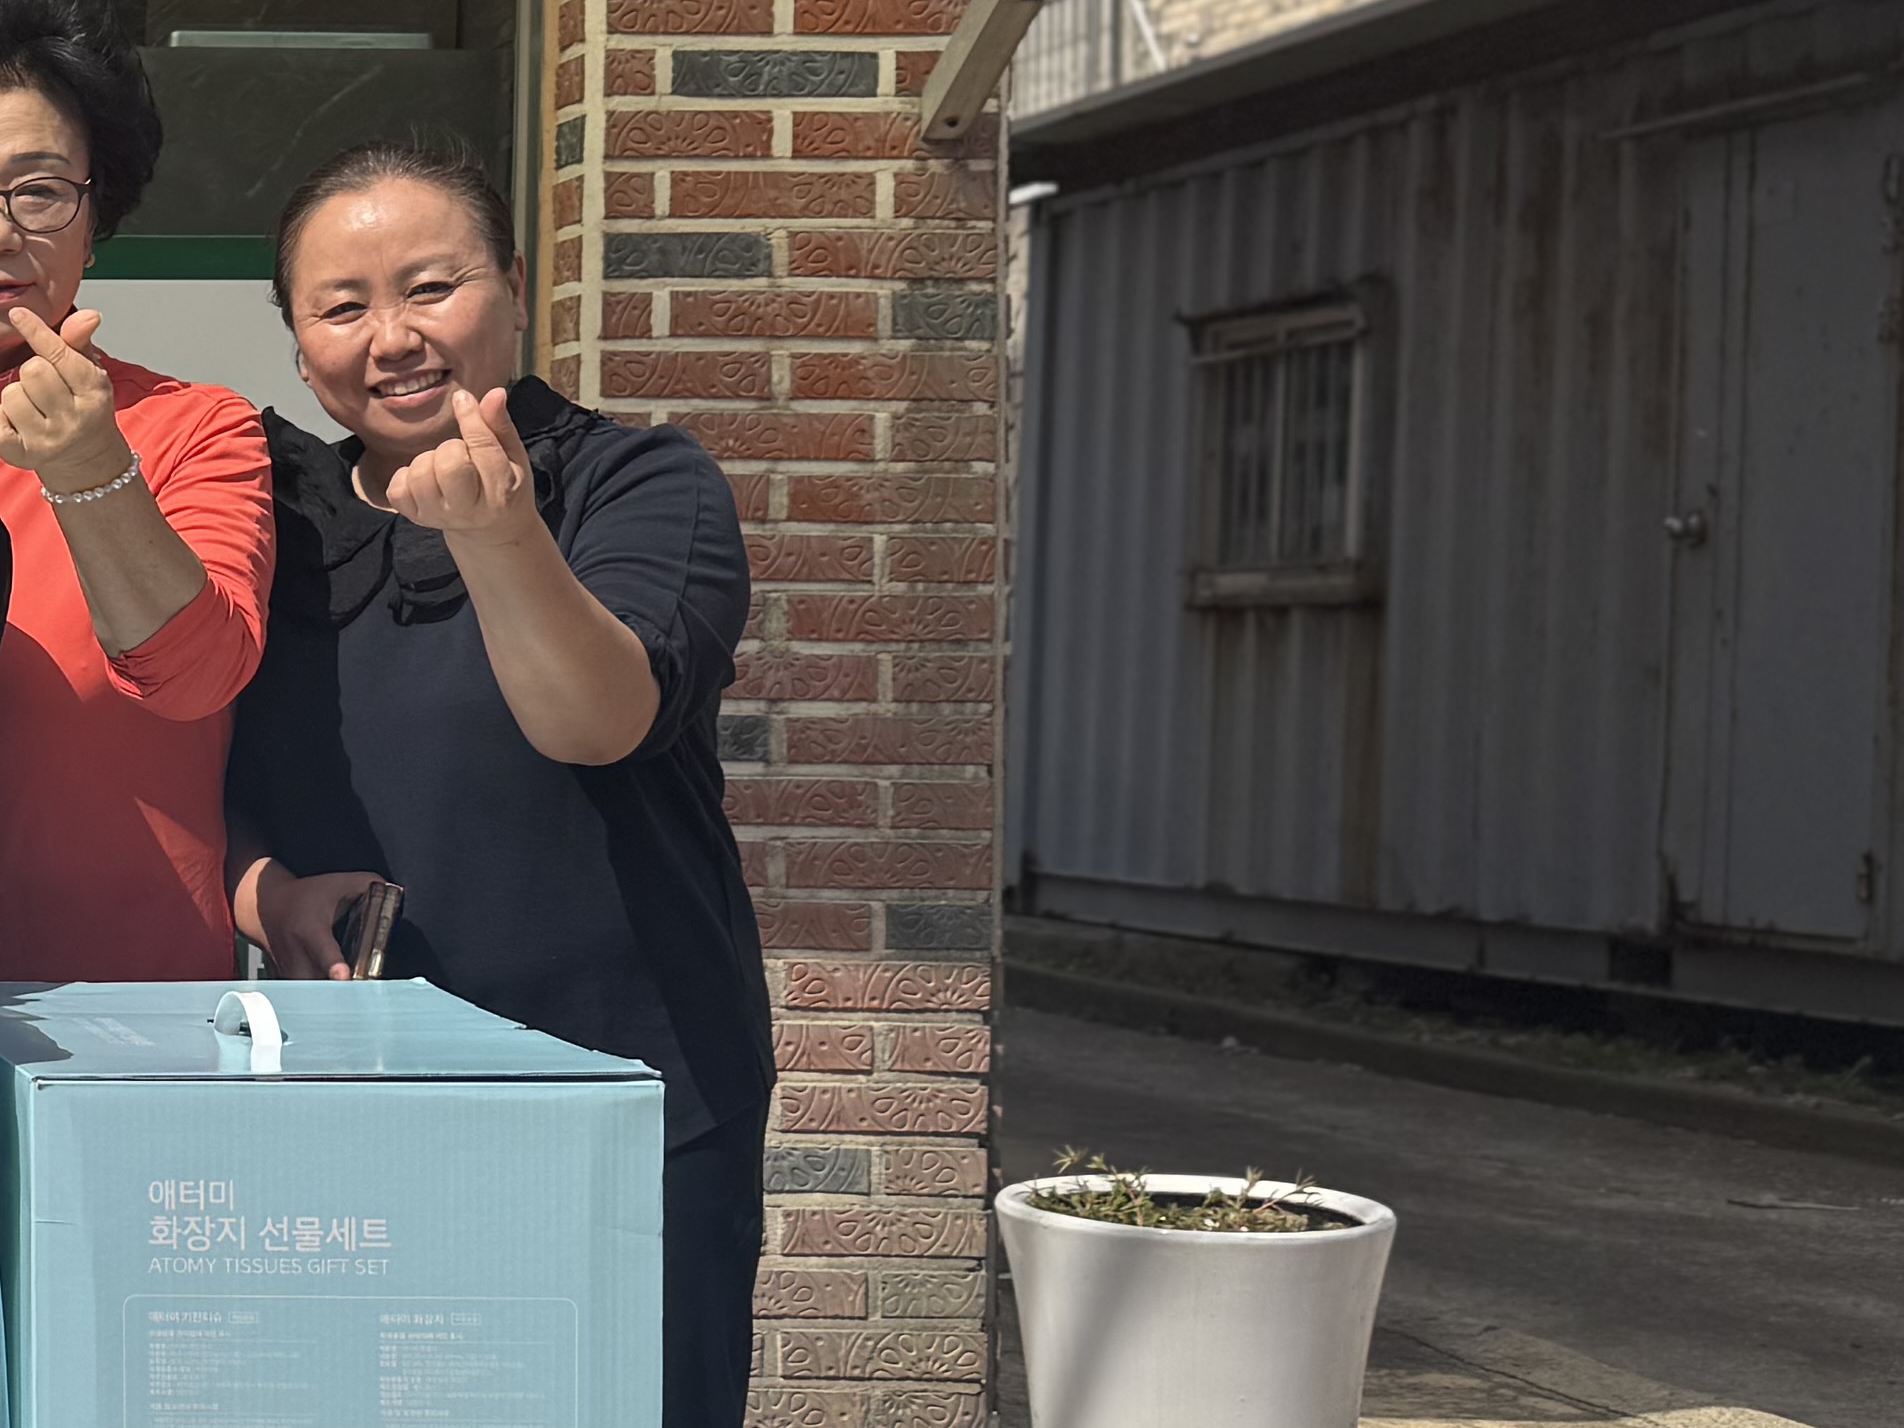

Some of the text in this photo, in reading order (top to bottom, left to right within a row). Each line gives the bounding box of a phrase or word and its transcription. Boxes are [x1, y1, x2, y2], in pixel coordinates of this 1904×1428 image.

[148, 1180, 234, 1211] 애터미
[148, 1215, 392, 1252] 화장지 선물세트
[148, 1258, 389, 1276] ATOMY TISSUES GIFT SET
